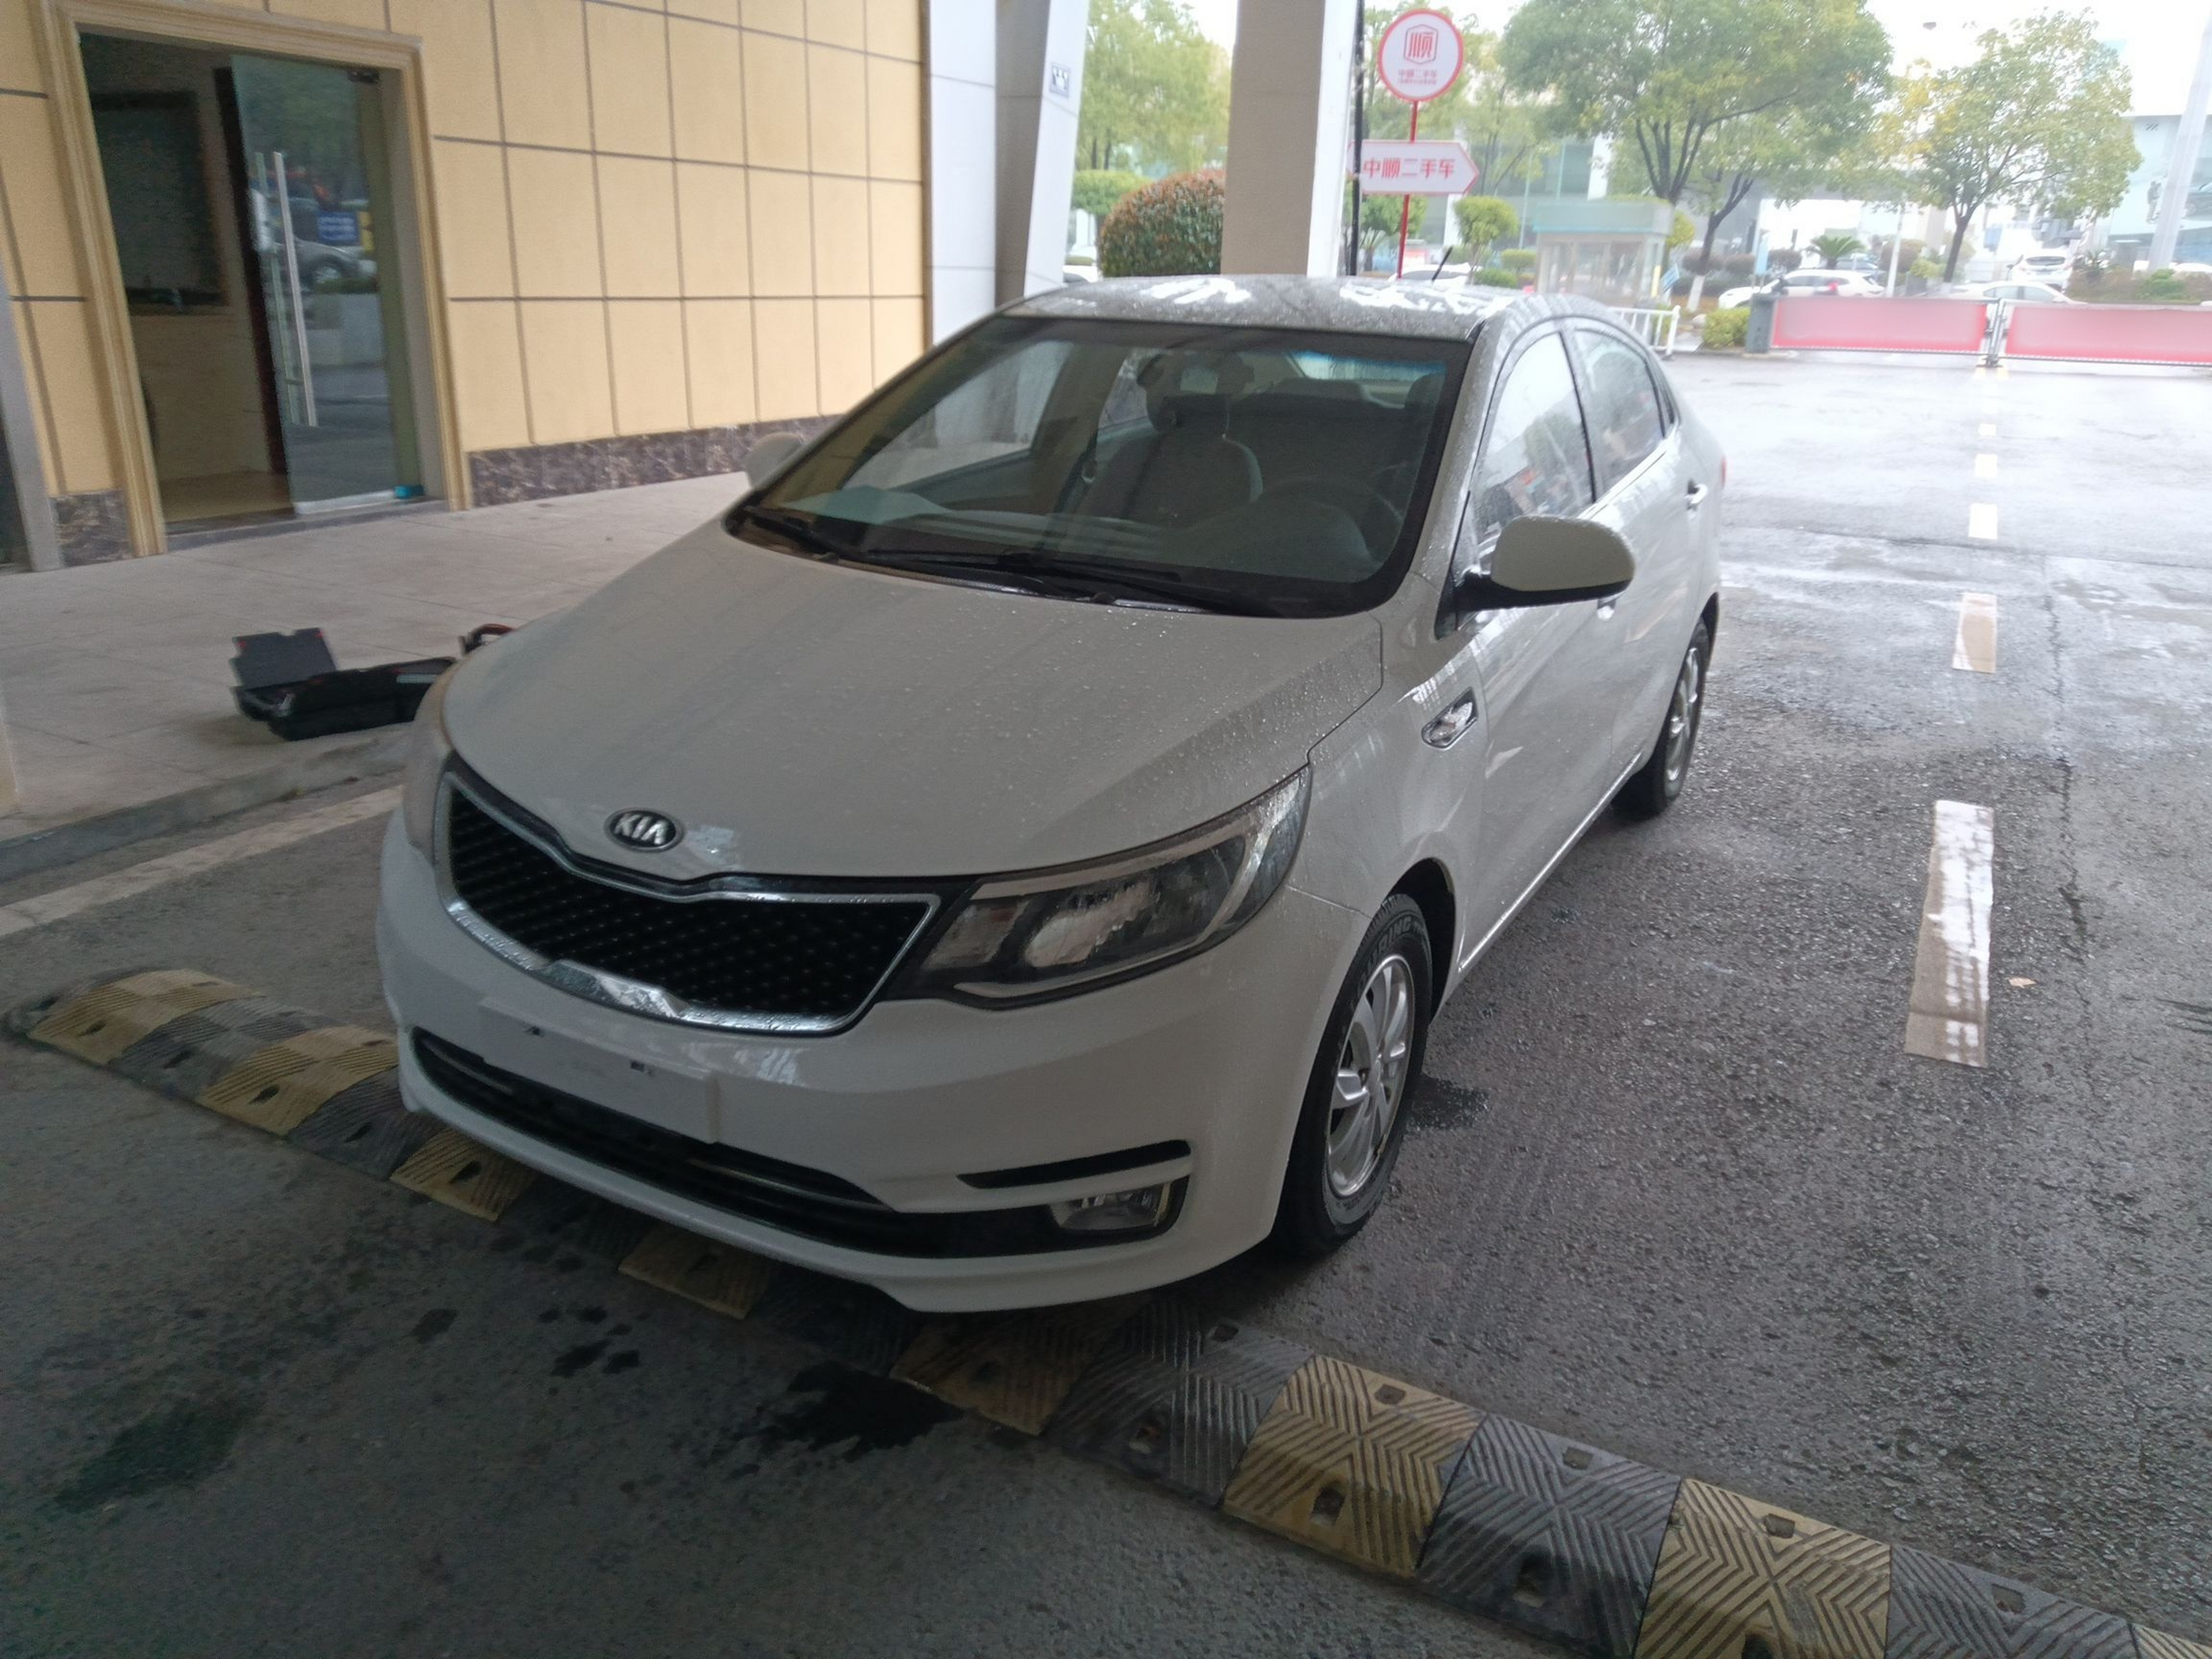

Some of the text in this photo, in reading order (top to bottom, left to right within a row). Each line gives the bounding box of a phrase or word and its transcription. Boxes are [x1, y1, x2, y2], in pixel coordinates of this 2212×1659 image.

[1408, 32, 1434, 58] 顺
[1363, 157, 1456, 179] 中顺二手车
[613, 813, 668, 845] KIA
